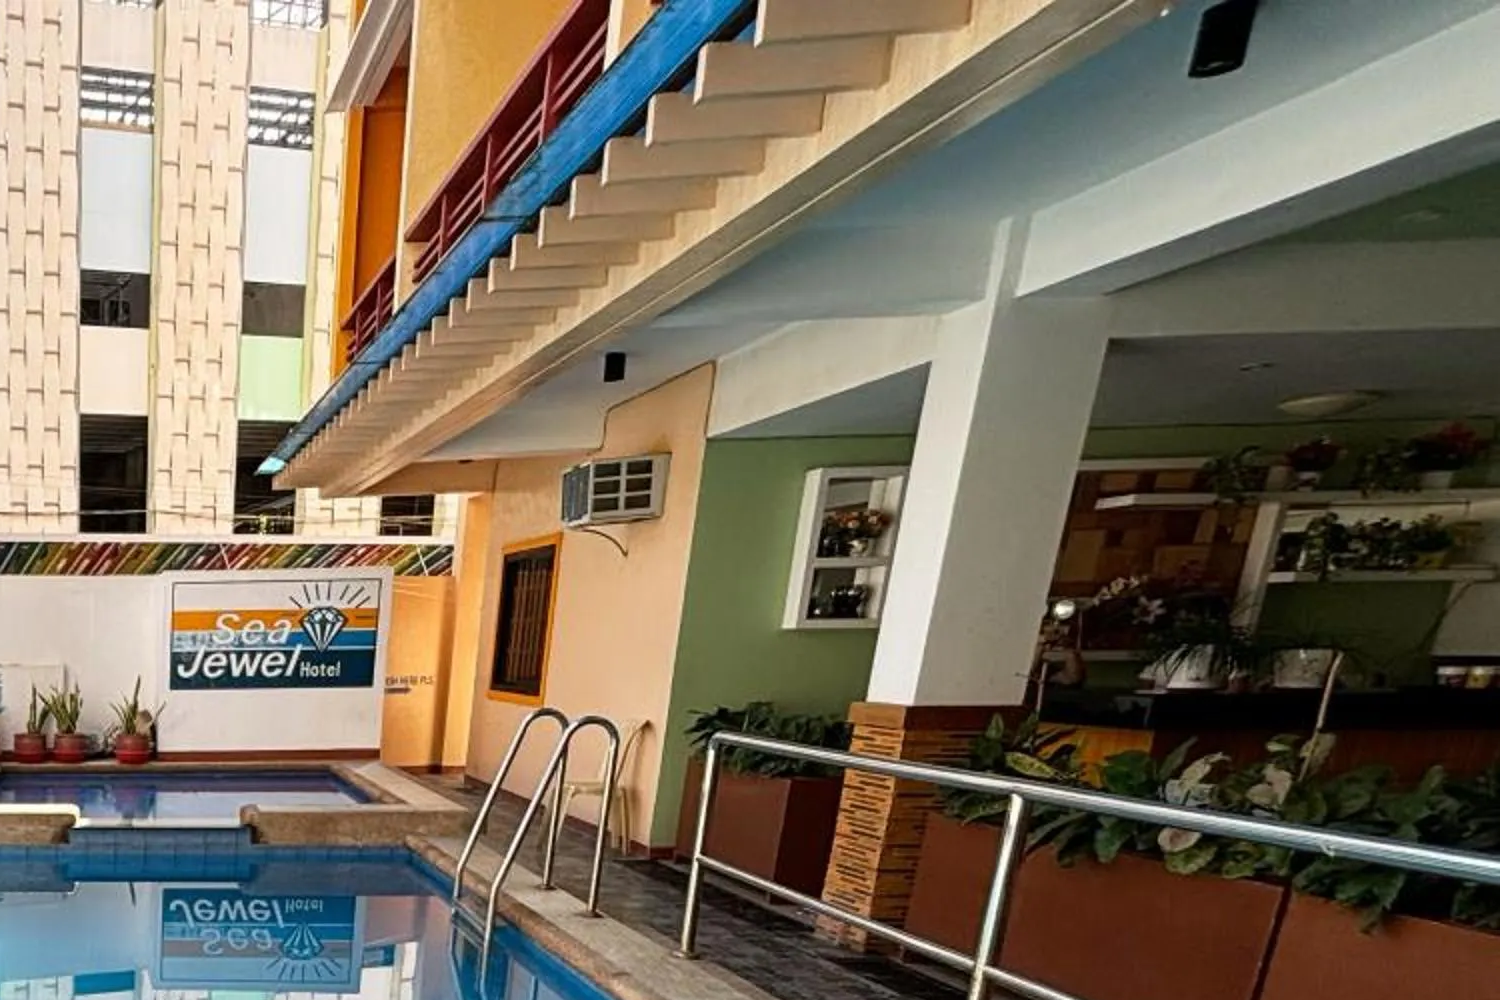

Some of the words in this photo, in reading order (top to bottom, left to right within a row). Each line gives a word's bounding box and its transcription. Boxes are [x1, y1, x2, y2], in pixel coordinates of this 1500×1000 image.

[213, 612, 292, 645] Sea
[177, 645, 300, 678] Jewel
[300, 660, 341, 678] Hotel
